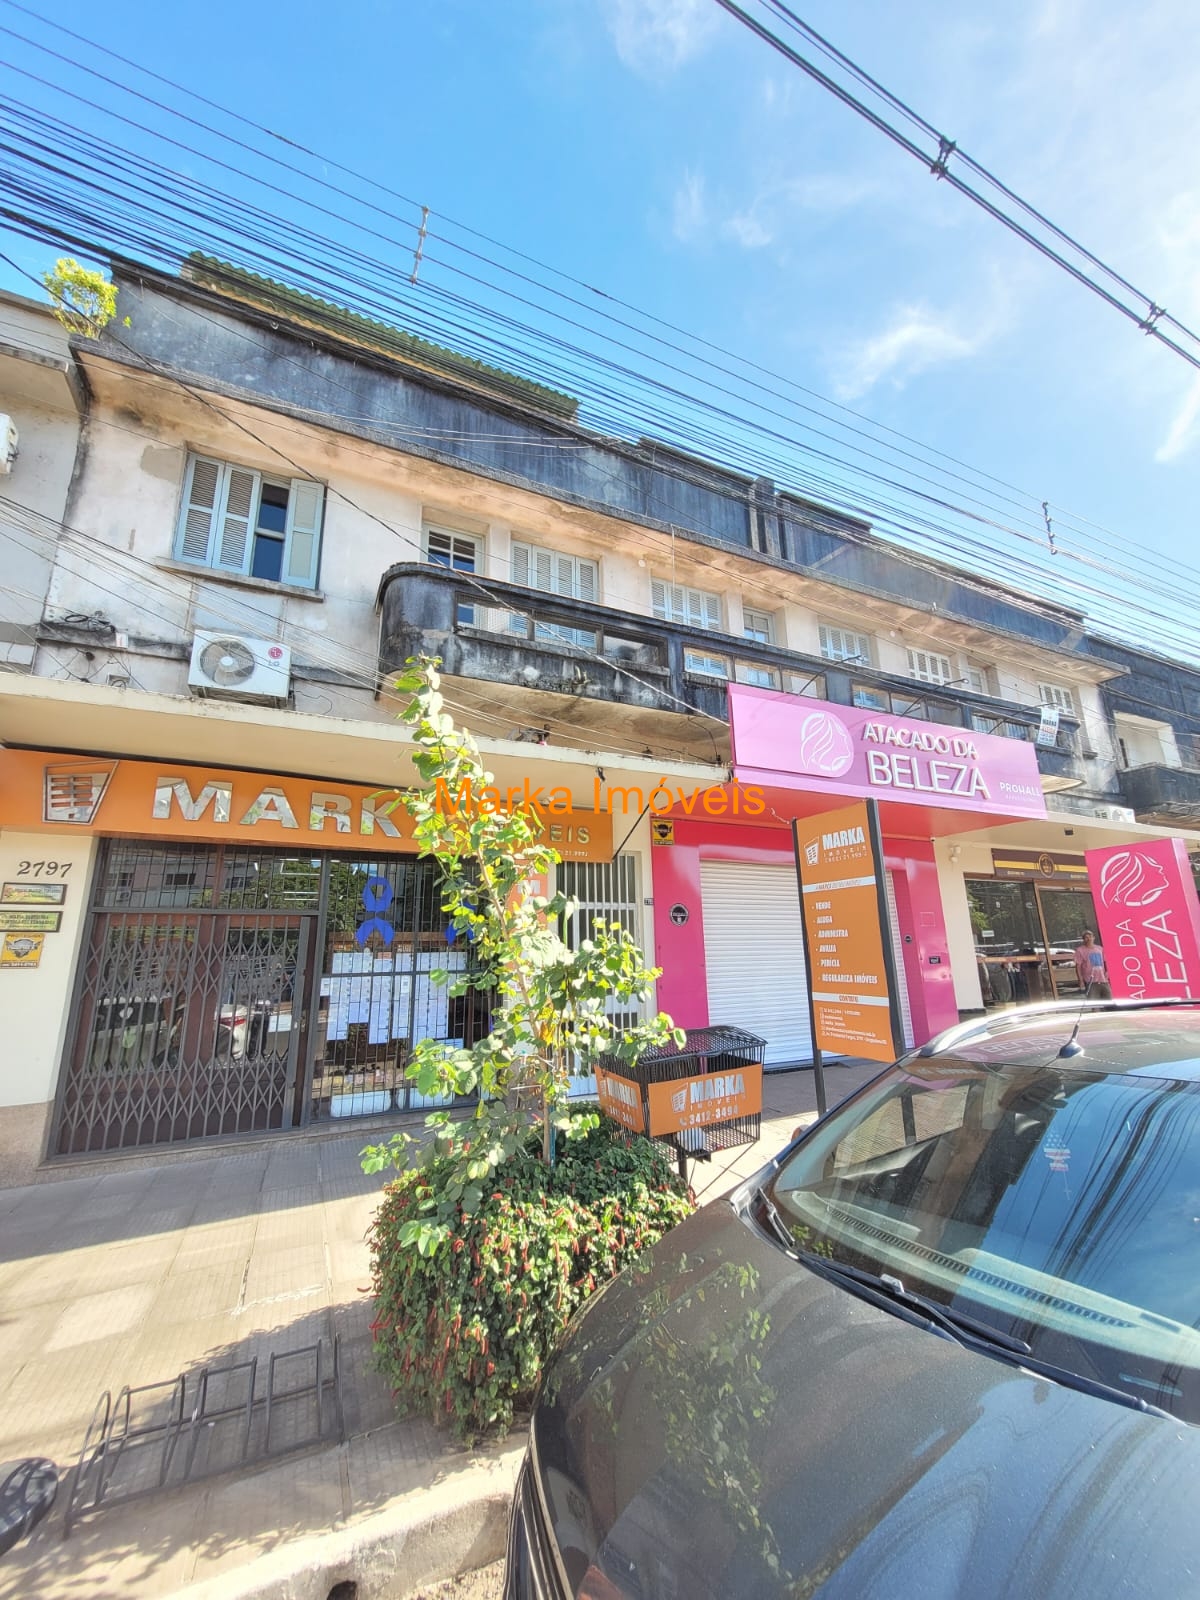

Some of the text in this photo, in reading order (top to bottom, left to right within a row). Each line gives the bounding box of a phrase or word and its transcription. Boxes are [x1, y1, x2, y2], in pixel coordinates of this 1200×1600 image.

[863, 721, 979, 760] ATACADO DA
[866, 750, 991, 800] BELEZA
[152, 776, 402, 840] MARK
[822, 826, 865, 850] MARKA
[17, 860, 72, 878] 2797
[689, 1073, 746, 1104] MARKA
